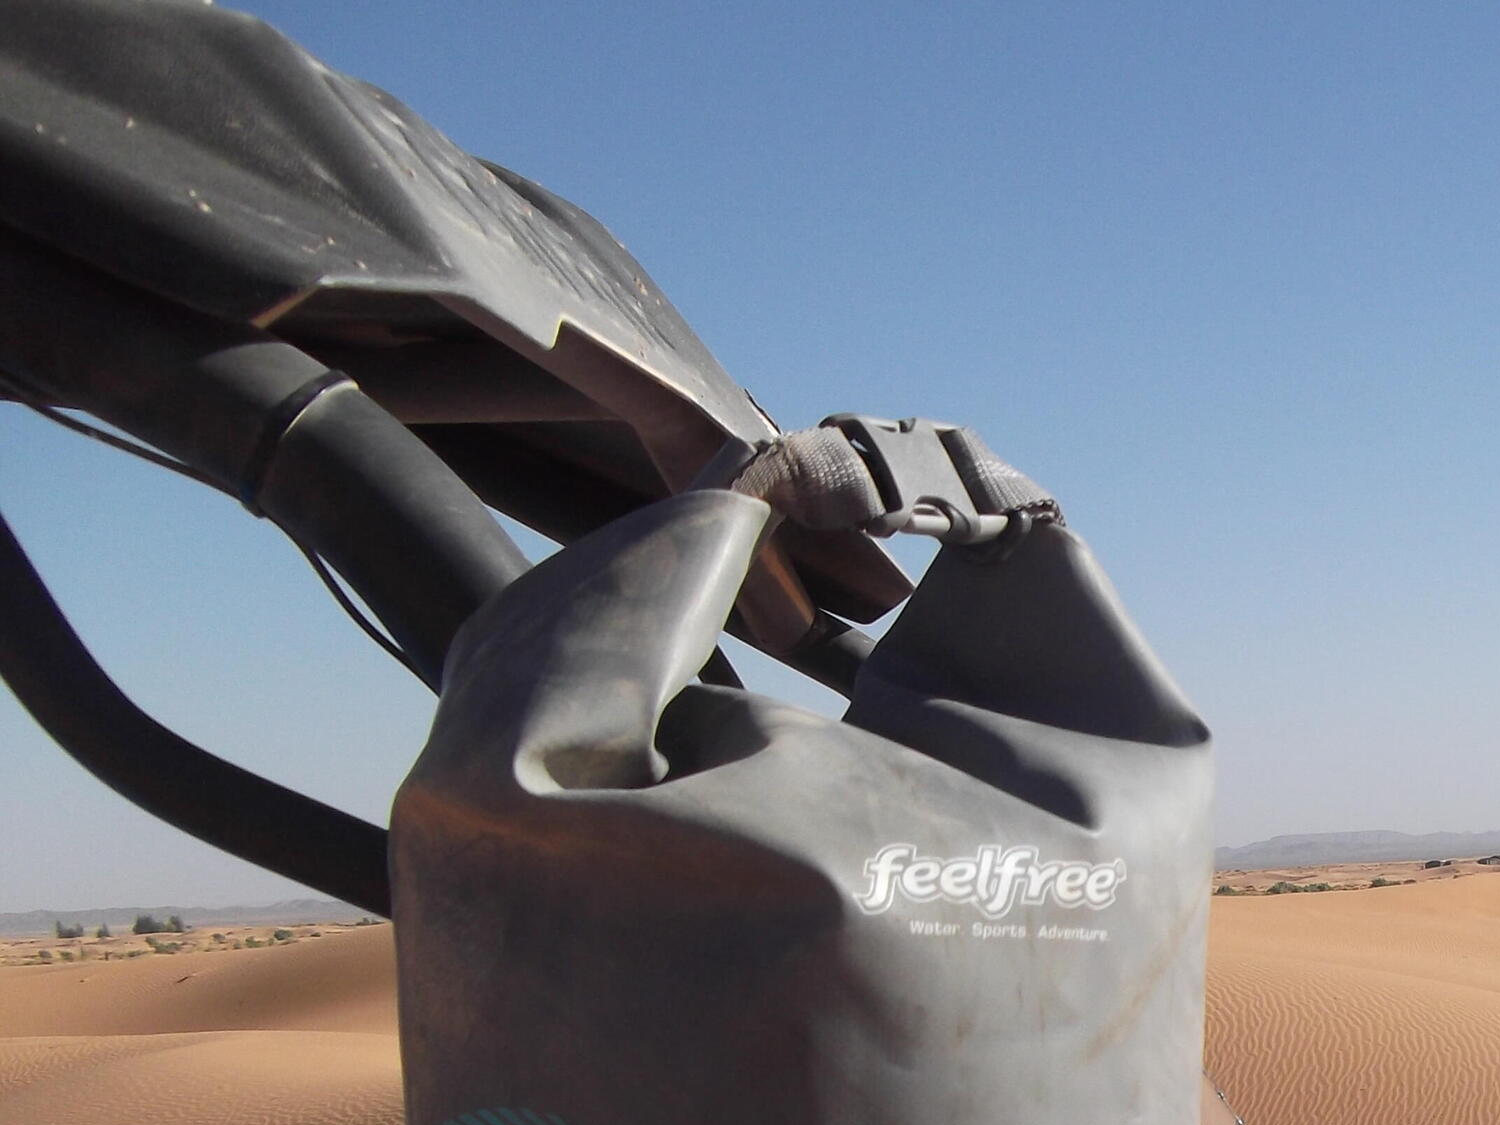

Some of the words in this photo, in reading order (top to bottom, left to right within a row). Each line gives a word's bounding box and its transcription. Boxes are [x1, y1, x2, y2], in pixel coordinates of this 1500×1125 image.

[854, 843, 1126, 919] feelfree
[909, 919, 961, 936] Water
[972, 922, 1027, 939] Sports
[1037, 924, 1109, 942] Adventure
